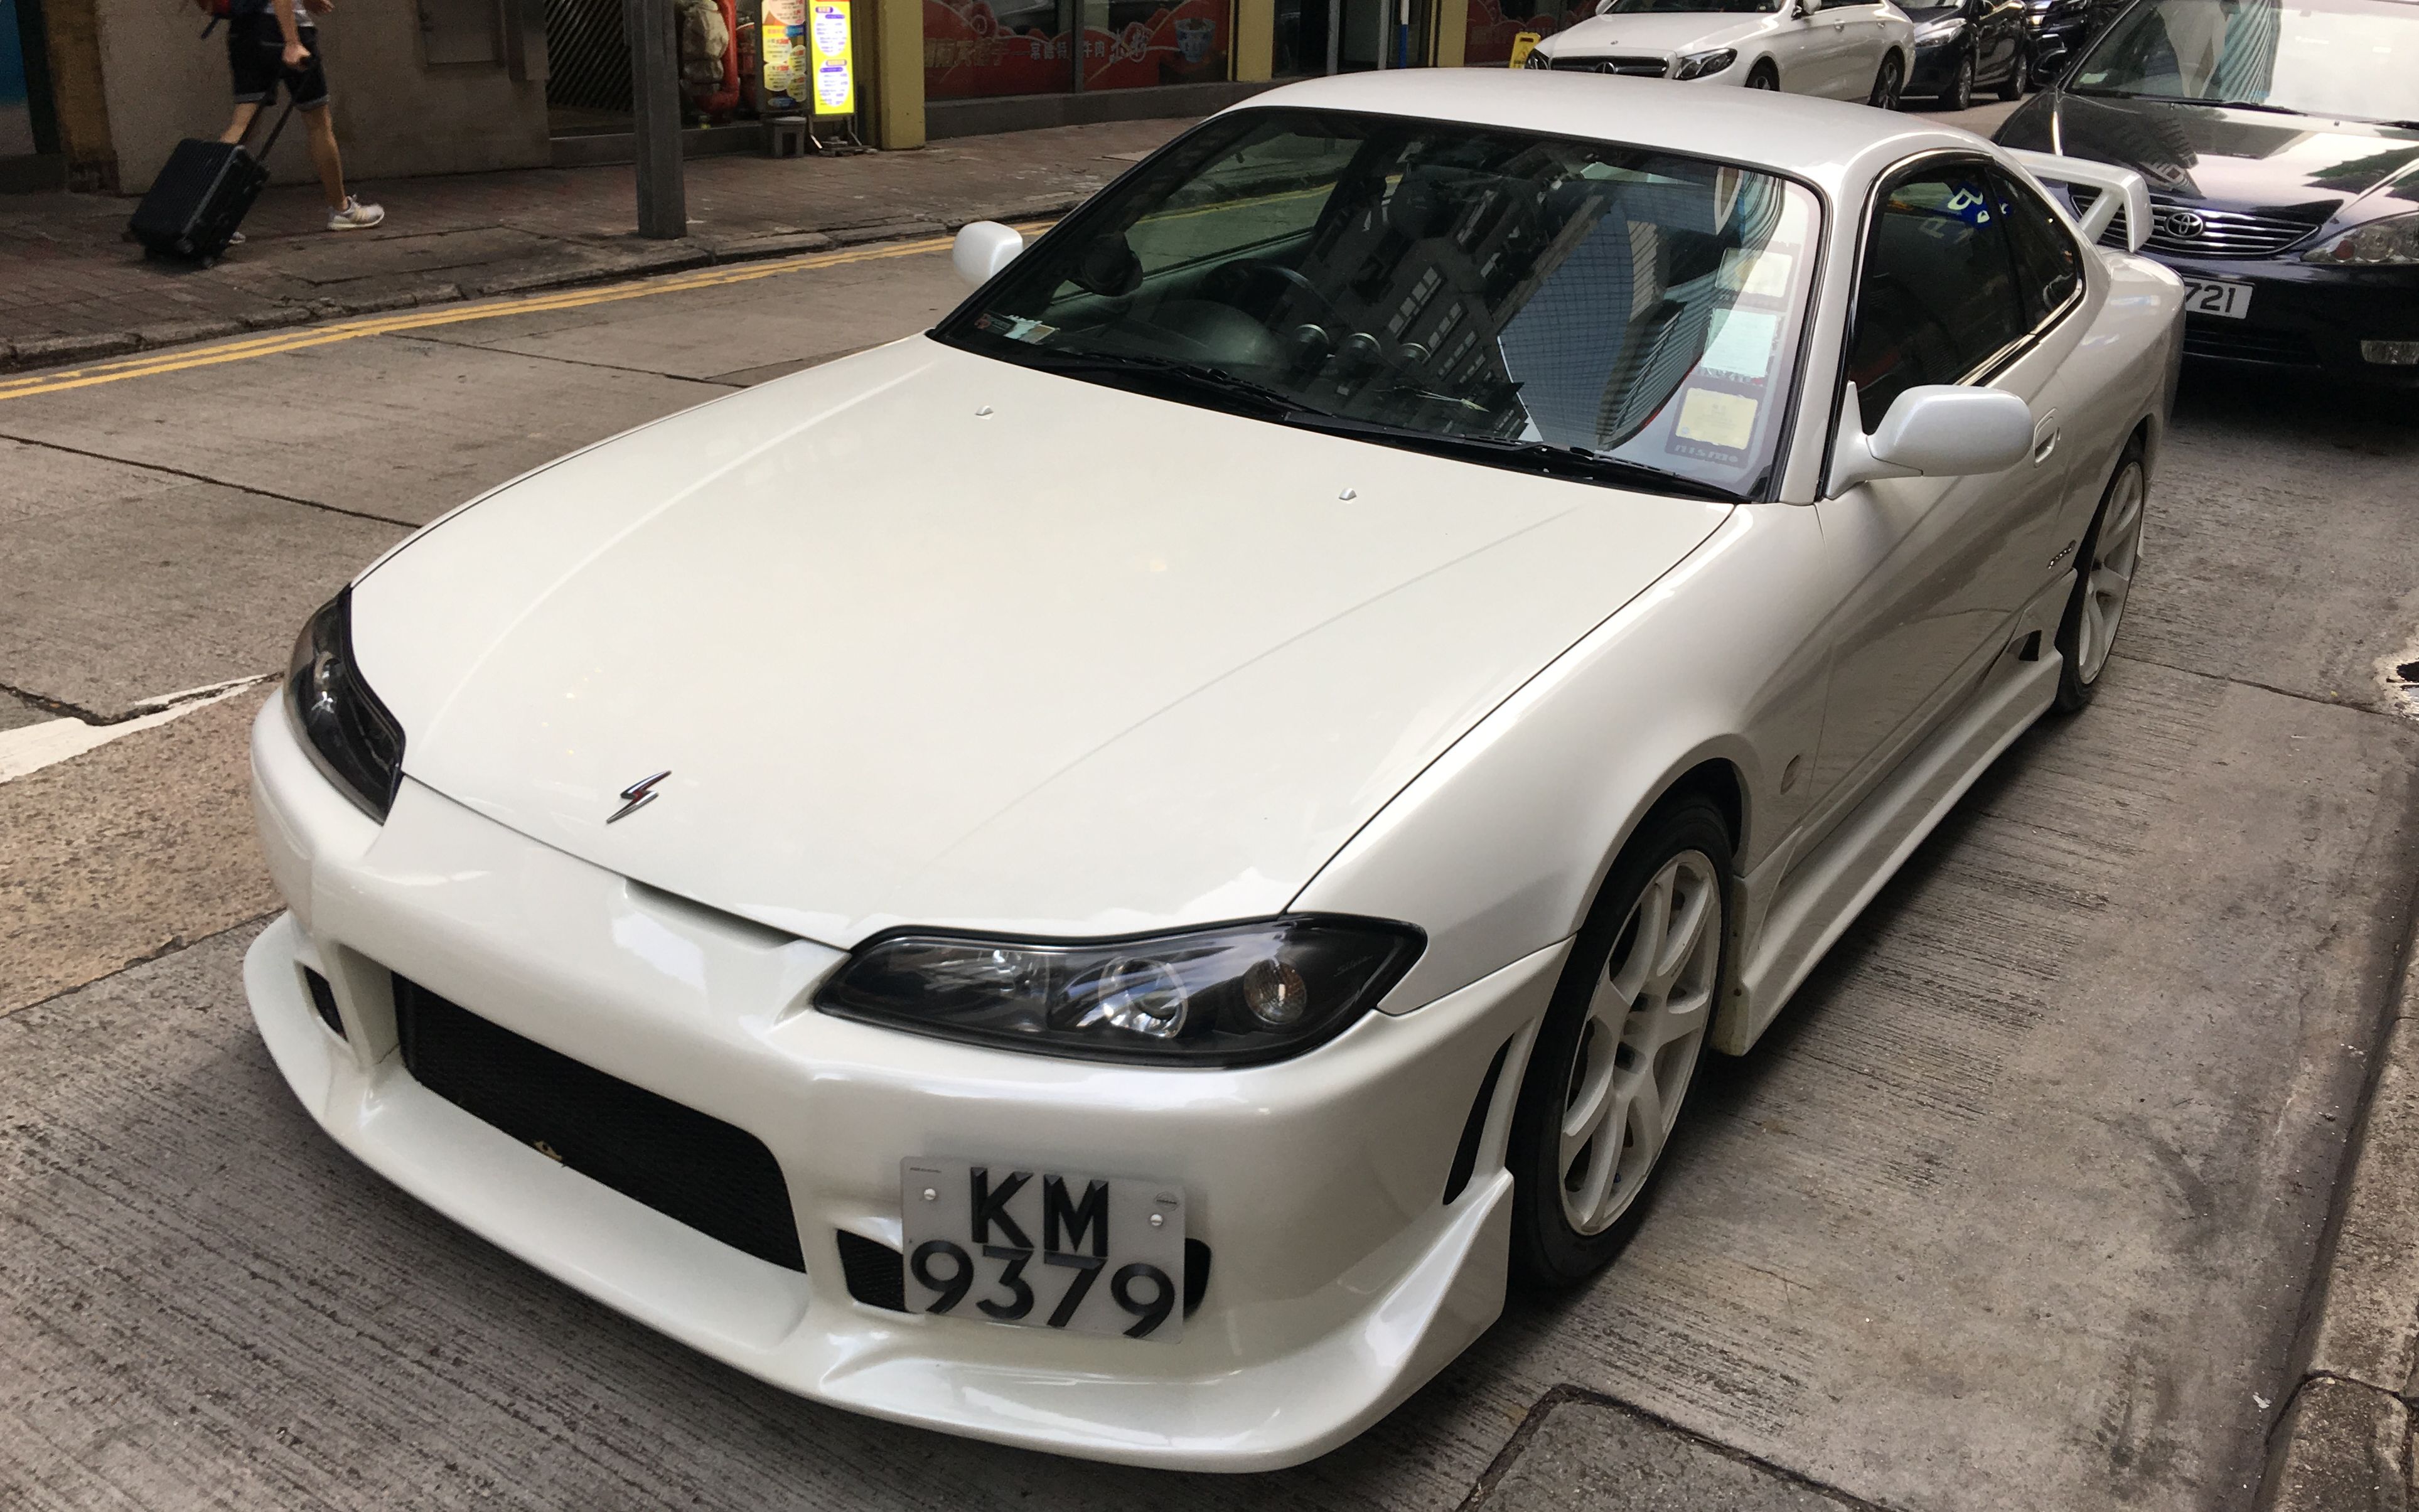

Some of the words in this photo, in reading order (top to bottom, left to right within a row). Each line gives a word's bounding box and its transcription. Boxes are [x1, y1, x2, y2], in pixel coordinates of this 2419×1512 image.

[2184, 281, 2236, 313] 721
[970, 1167, 1109, 1258] KM
[911, 1240, 1176, 1339] 9379
